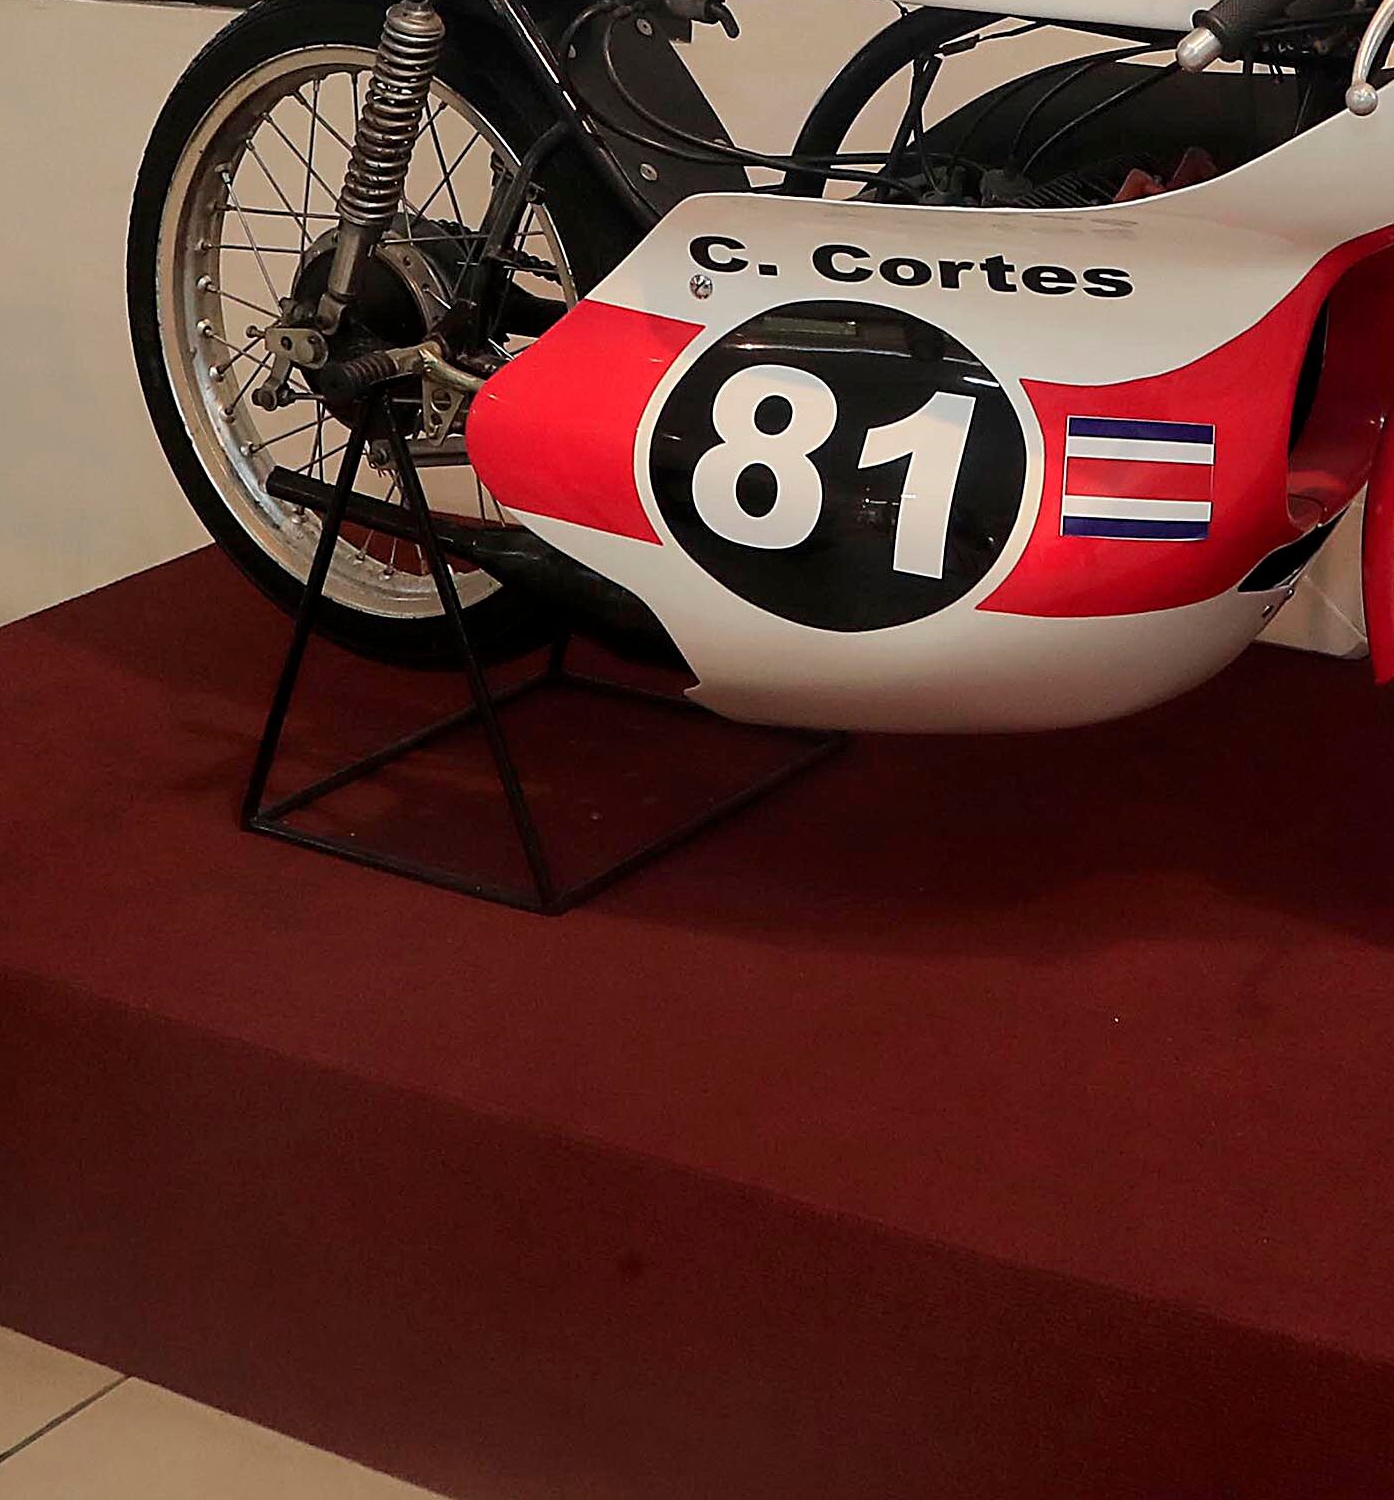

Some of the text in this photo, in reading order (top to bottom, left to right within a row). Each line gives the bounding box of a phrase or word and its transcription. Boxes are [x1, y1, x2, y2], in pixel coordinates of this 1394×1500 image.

[689, 235, 1135, 298] C. Cortes
[692, 363, 976, 580] 81
